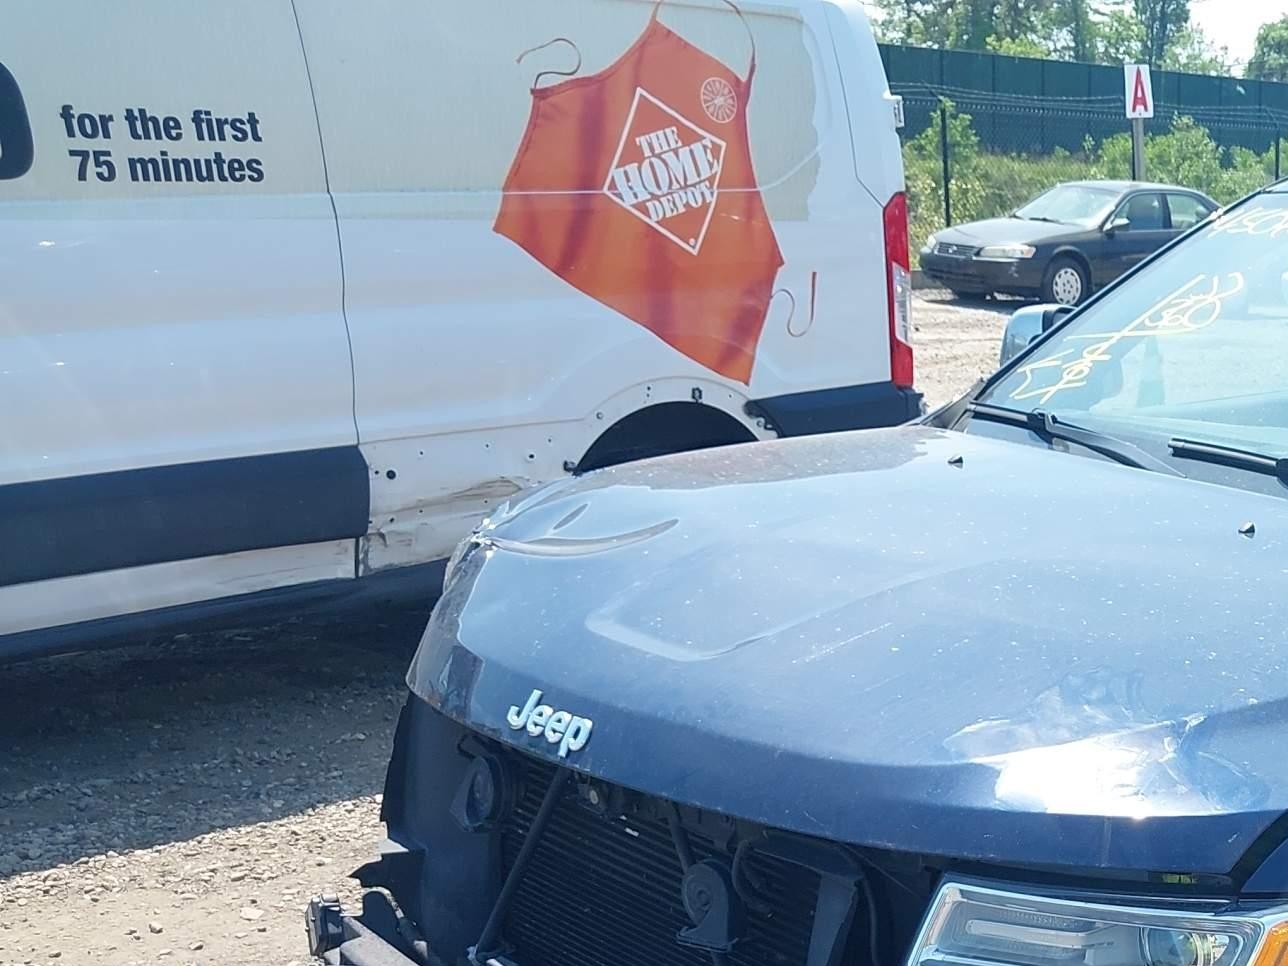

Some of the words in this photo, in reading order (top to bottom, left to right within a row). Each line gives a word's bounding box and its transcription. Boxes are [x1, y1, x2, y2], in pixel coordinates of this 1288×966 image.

[1132, 66, 1148, 113] A
[60, 104, 114, 140] for
[124, 108, 183, 142] the
[192, 109, 263, 143] first
[635, 126, 682, 158] THE
[68, 149, 117, 183] 75
[128, 150, 265, 183] minutes
[612, 137, 720, 206] HOME
[645, 180, 715, 223] DEPOT
[506, 688, 593, 758] Jeep
